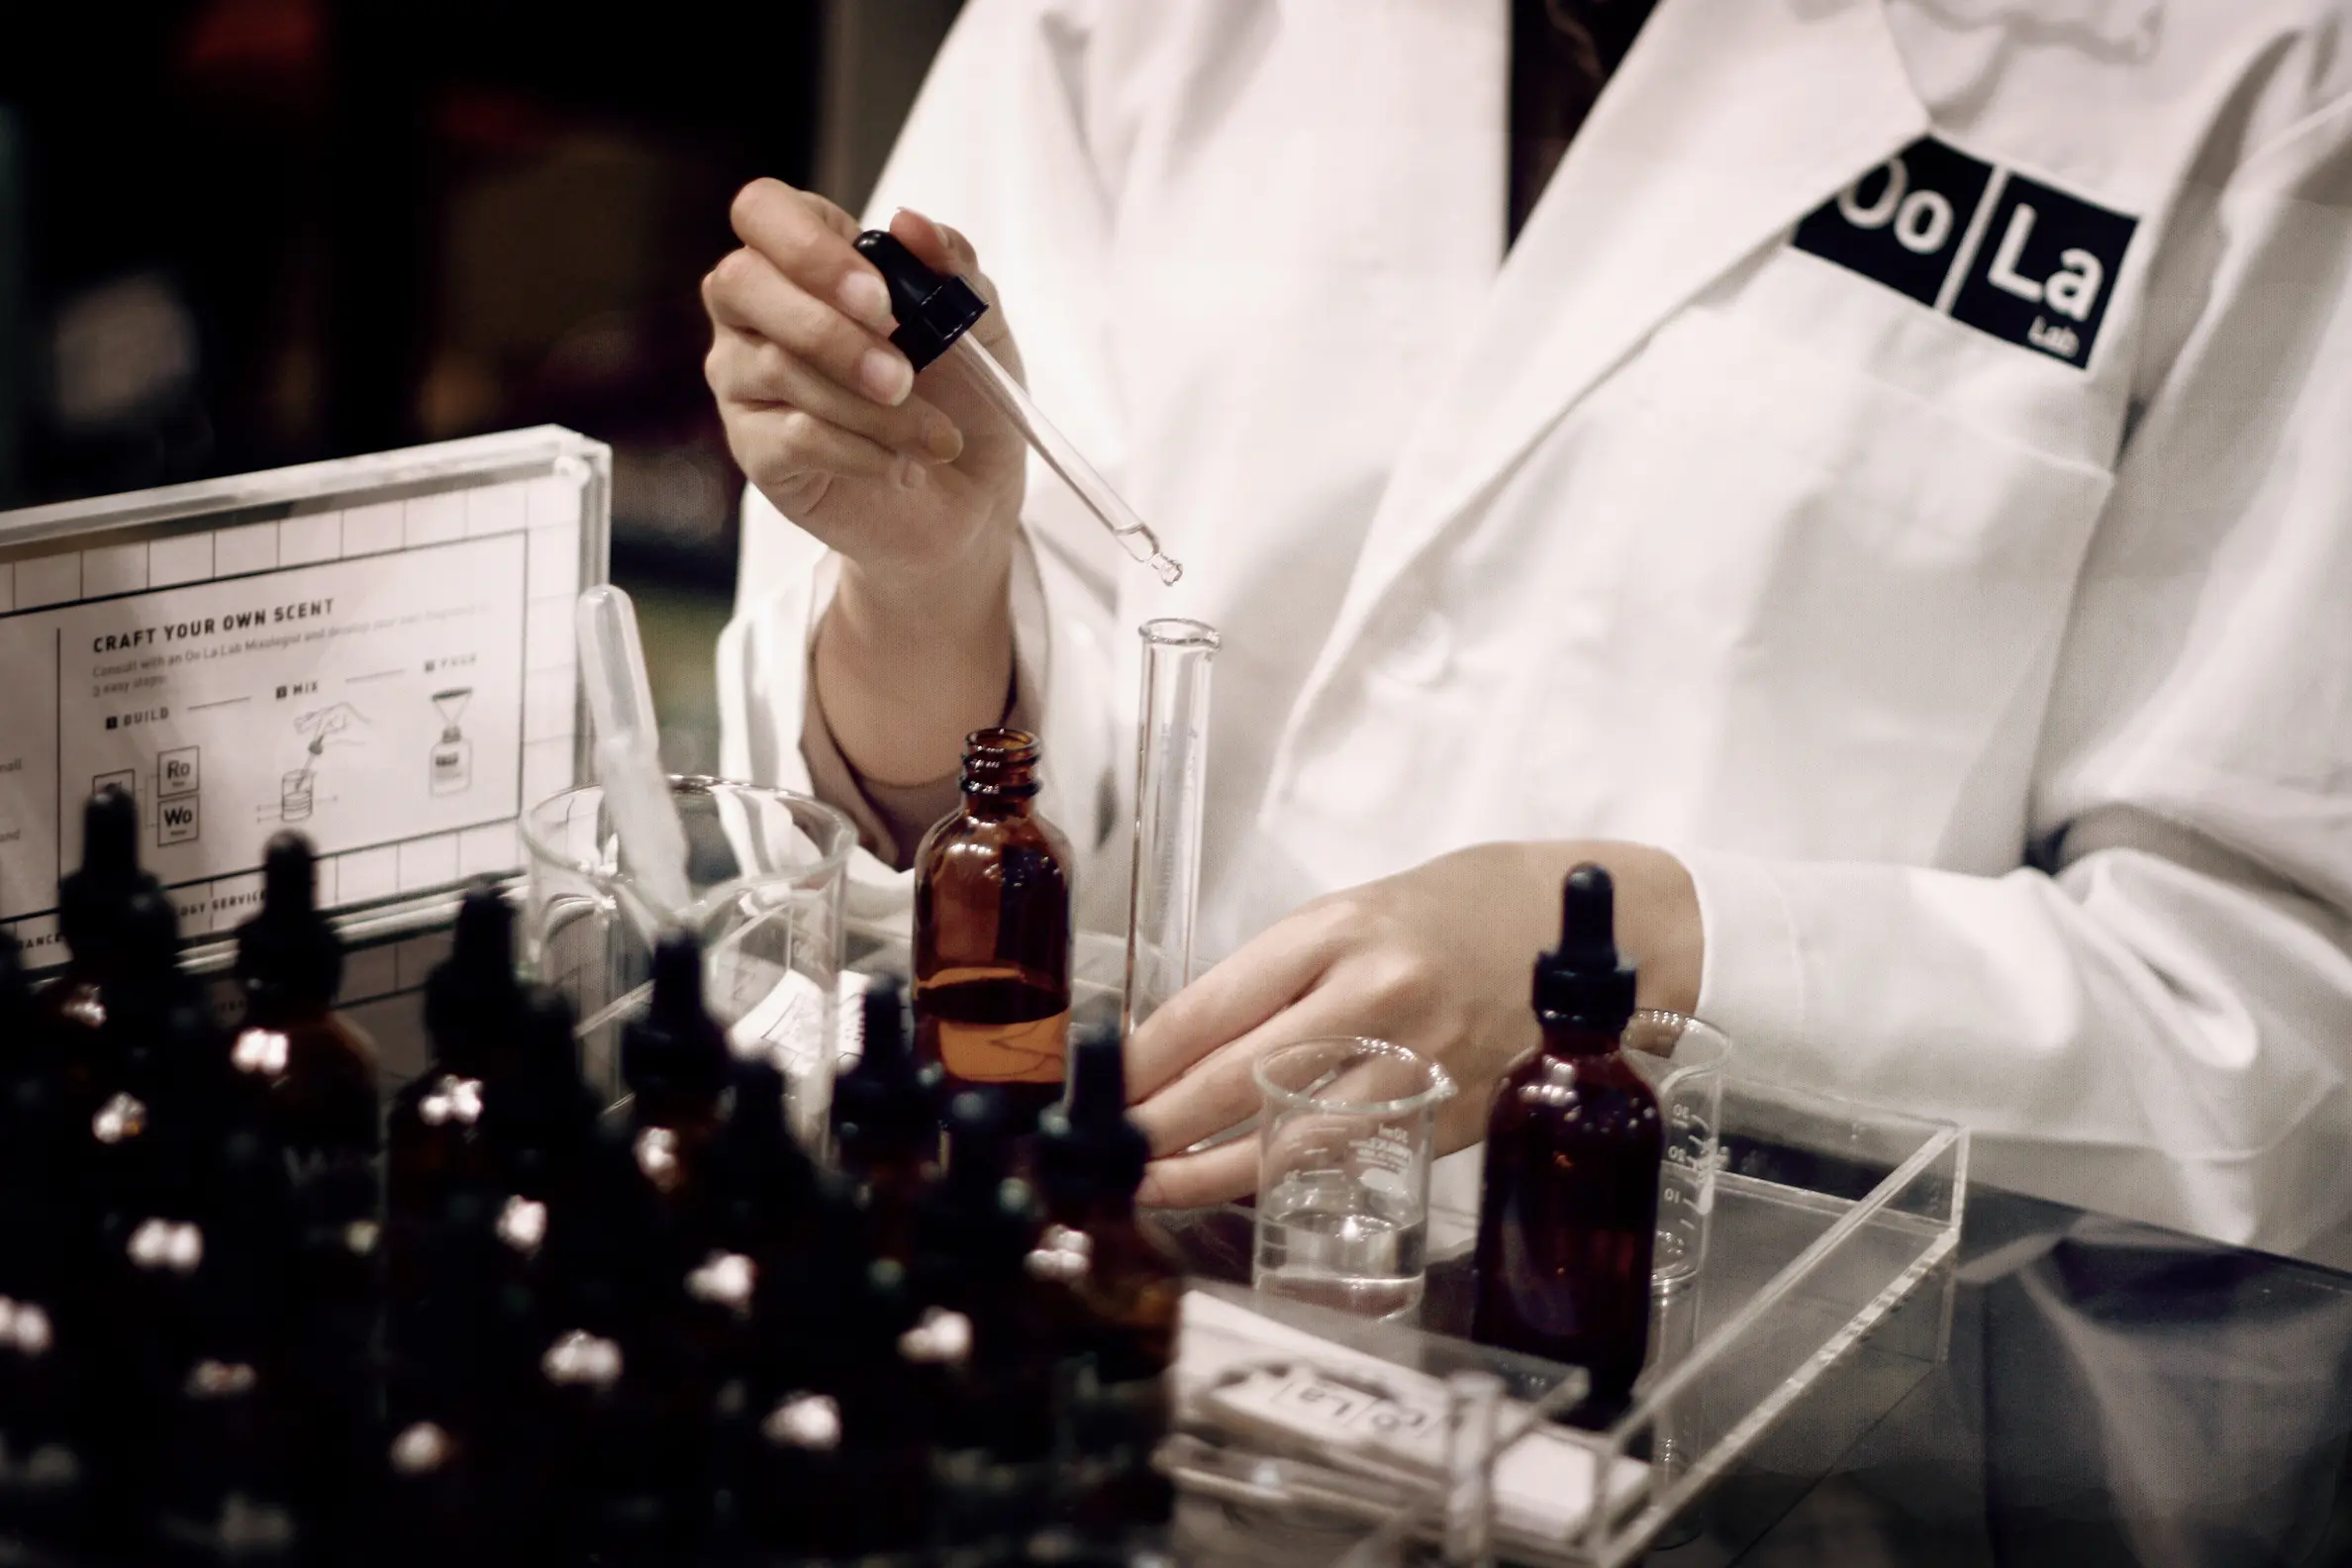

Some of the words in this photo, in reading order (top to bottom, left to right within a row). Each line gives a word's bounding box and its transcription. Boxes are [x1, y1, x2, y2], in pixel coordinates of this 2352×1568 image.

[1836, 156, 1954, 254] Oo
[1987, 202, 2105, 321] La
[2027, 316, 2079, 357] Lab
[93, 628, 156, 653] CRAFT
[164, 618, 215, 641] YOUR
[223, 609, 266, 632] OWN
[274, 598, 335, 624] SCENT
[92, 660, 137, 677] Consult
[141, 656, 165, 669] with
[221, 643, 242, 656] Lab
[293, 681, 318, 695] MIX
[124, 707, 169, 728] BUILD
[167, 760, 190, 780] Ro
[164, 806, 192, 828] Wo
